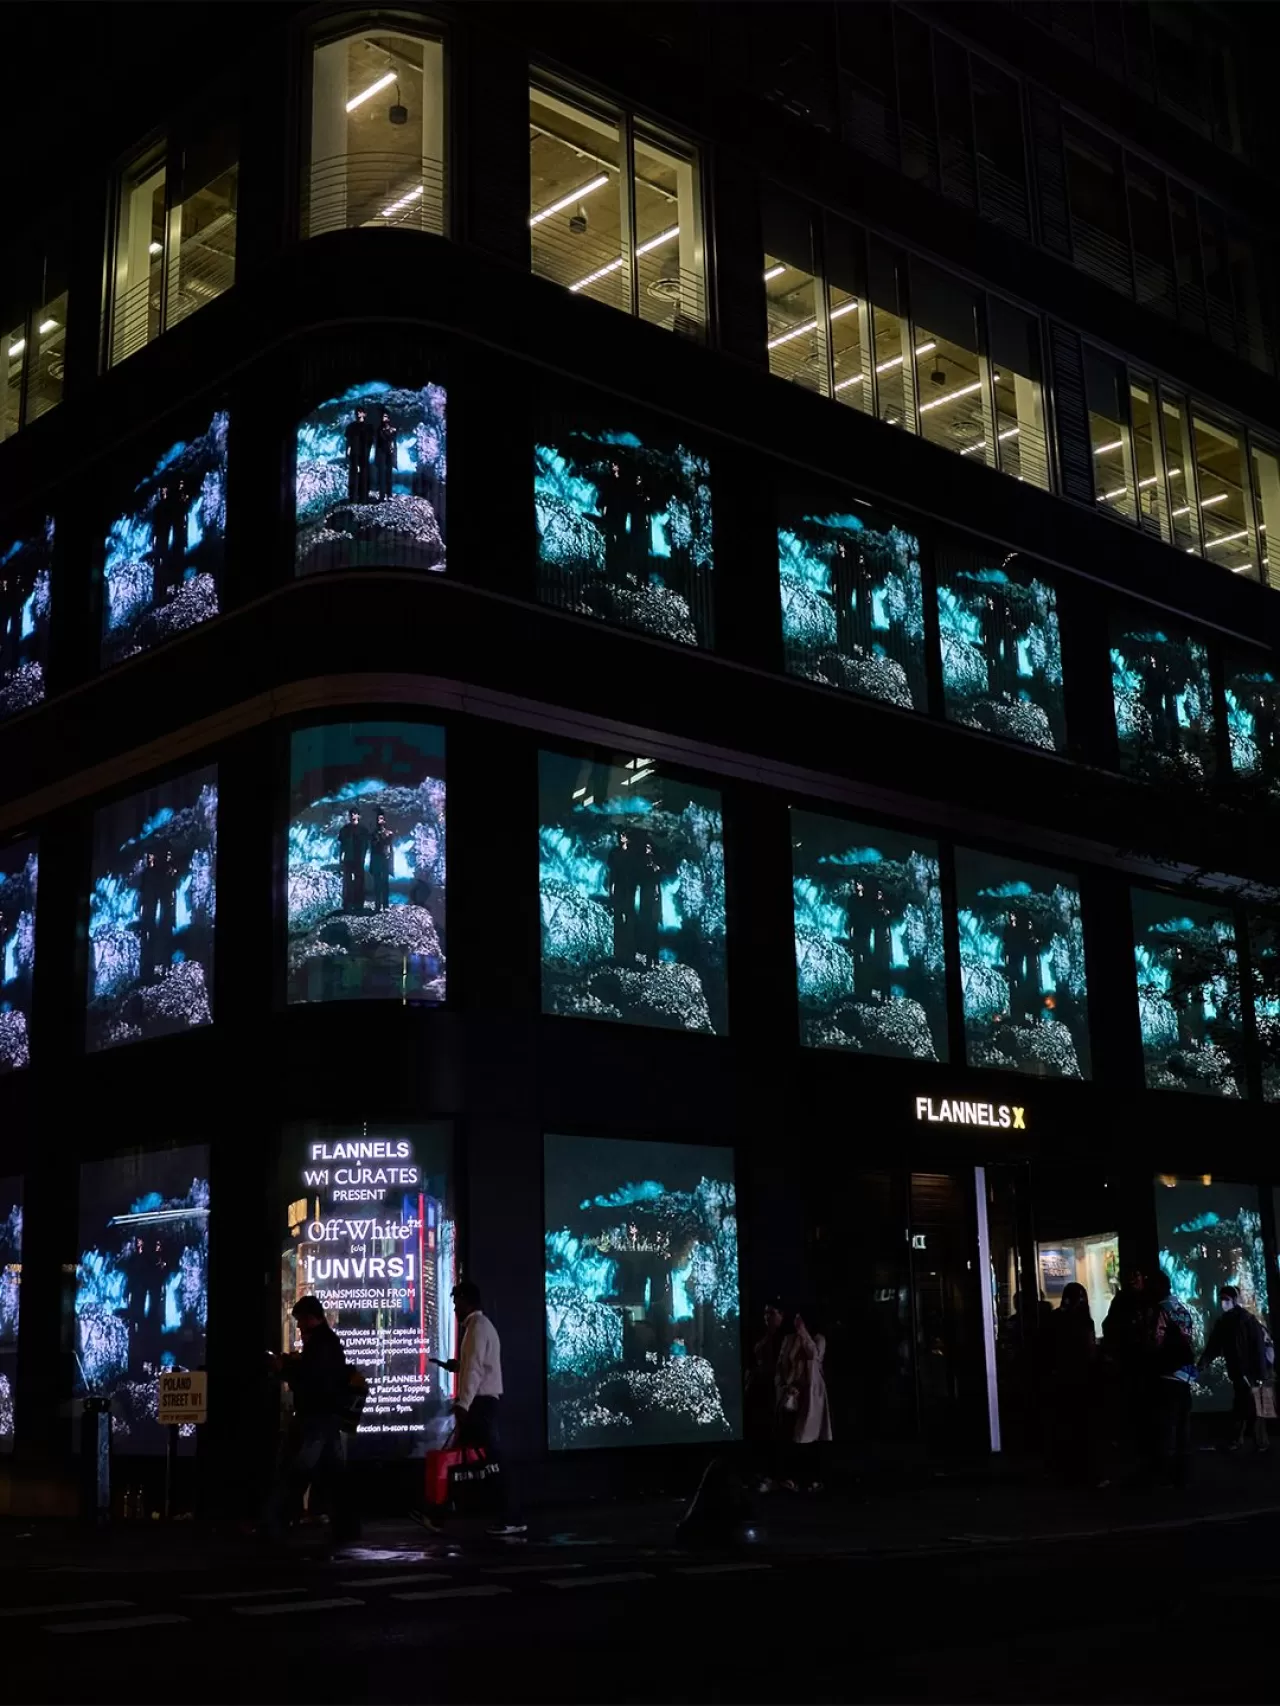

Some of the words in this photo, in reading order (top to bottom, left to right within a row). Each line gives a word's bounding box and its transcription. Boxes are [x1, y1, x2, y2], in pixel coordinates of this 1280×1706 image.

[312, 1142, 410, 1161] FLANNELS
[304, 1170, 329, 1186] W1
[334, 1167, 418, 1185] CURATES
[333, 1189, 386, 1201] PRESENT
[306, 1253, 415, 1283] [UNVRS]
[314, 1288, 385, 1299] TRANSMISSION
[387, 1287, 416, 1297] FROM
[319, 1299, 379, 1309] OMEWHERE
[380, 1298, 402, 1308] ELSE
[163, 1376, 192, 1391] POLAND
[382, 1374, 423, 1384] FLANNELS
[162, 1392, 189, 1407] STREET
